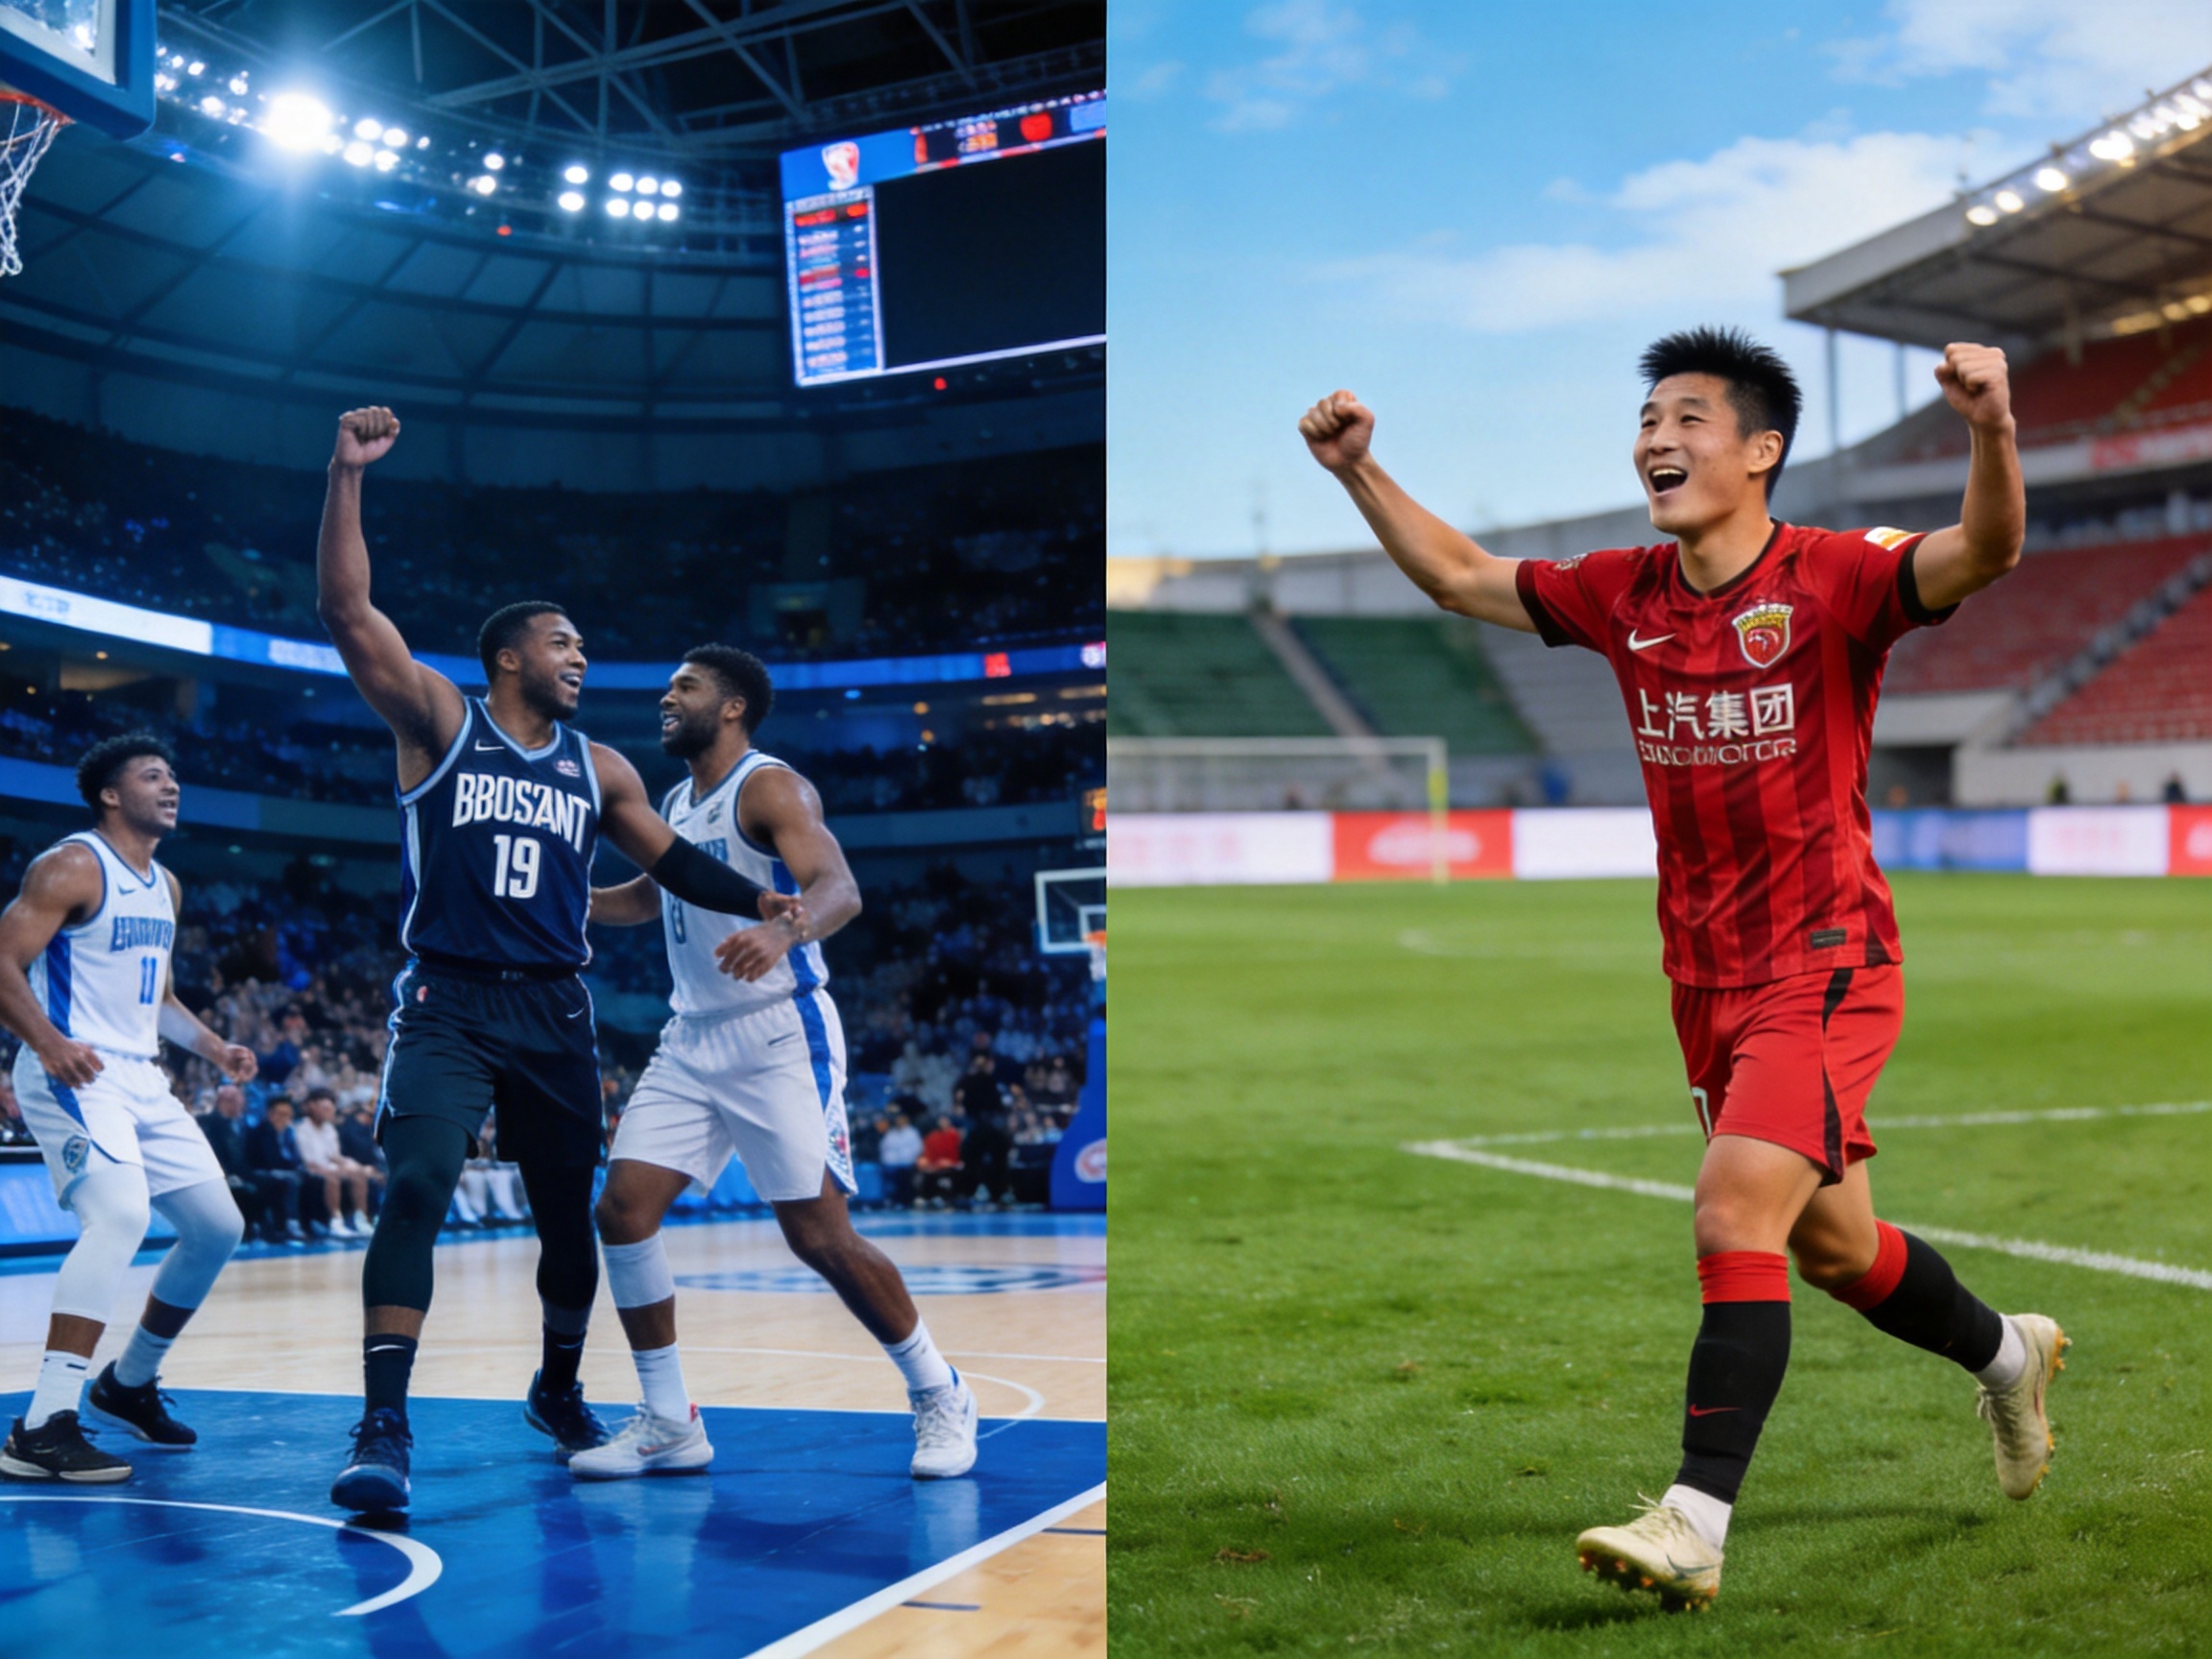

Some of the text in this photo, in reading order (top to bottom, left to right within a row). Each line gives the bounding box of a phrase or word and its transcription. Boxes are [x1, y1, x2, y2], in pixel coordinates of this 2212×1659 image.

[1638, 683, 1794, 740] 上汽集团
[493, 834, 541, 899] 19
